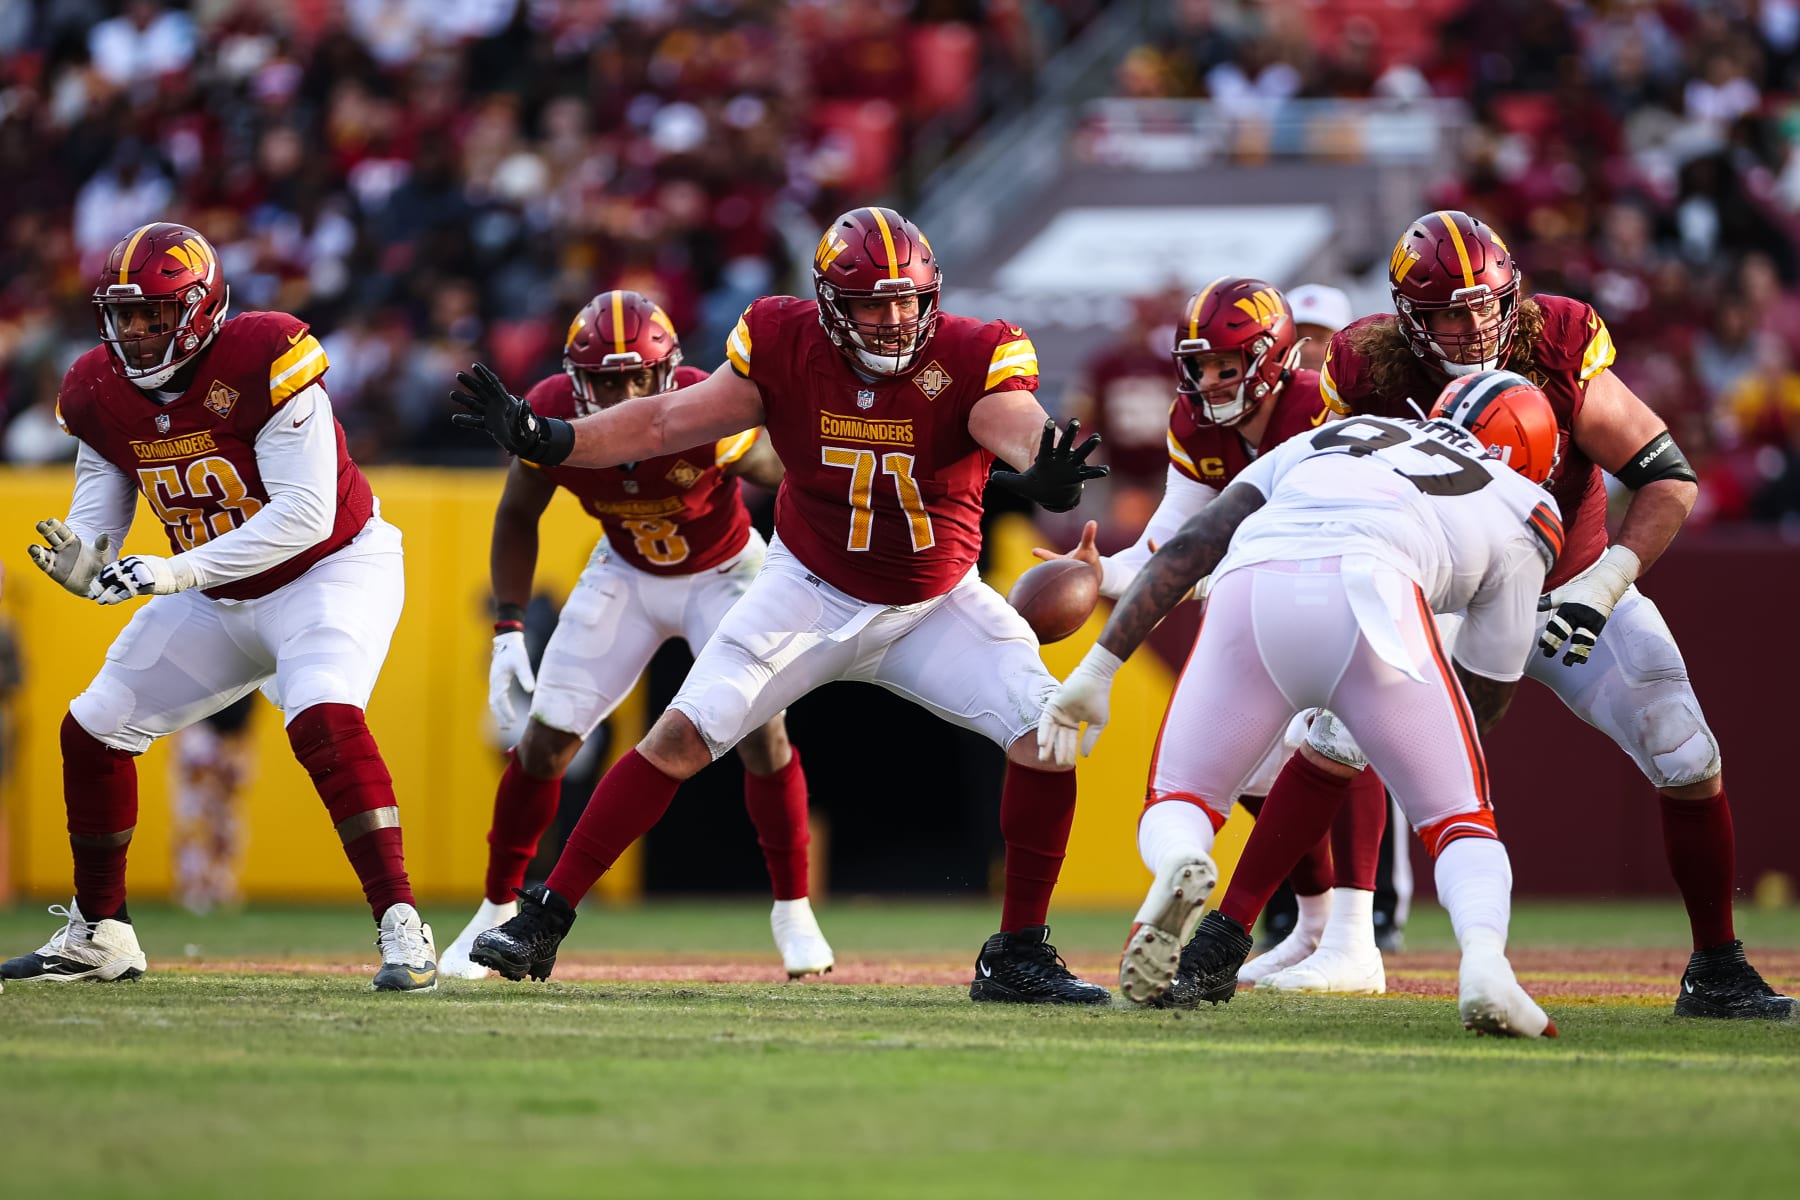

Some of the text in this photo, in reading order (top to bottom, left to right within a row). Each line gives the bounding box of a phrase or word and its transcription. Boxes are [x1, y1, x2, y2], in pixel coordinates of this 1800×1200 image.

[922, 370, 943, 391] 90
[820, 415, 914, 443] COMMANDERS
[132, 433, 217, 459] COMMANDERS
[1200, 457, 1225, 476] C
[136, 456, 264, 552] 53
[821, 445, 936, 553] 71
[621, 519, 691, 566] 8
